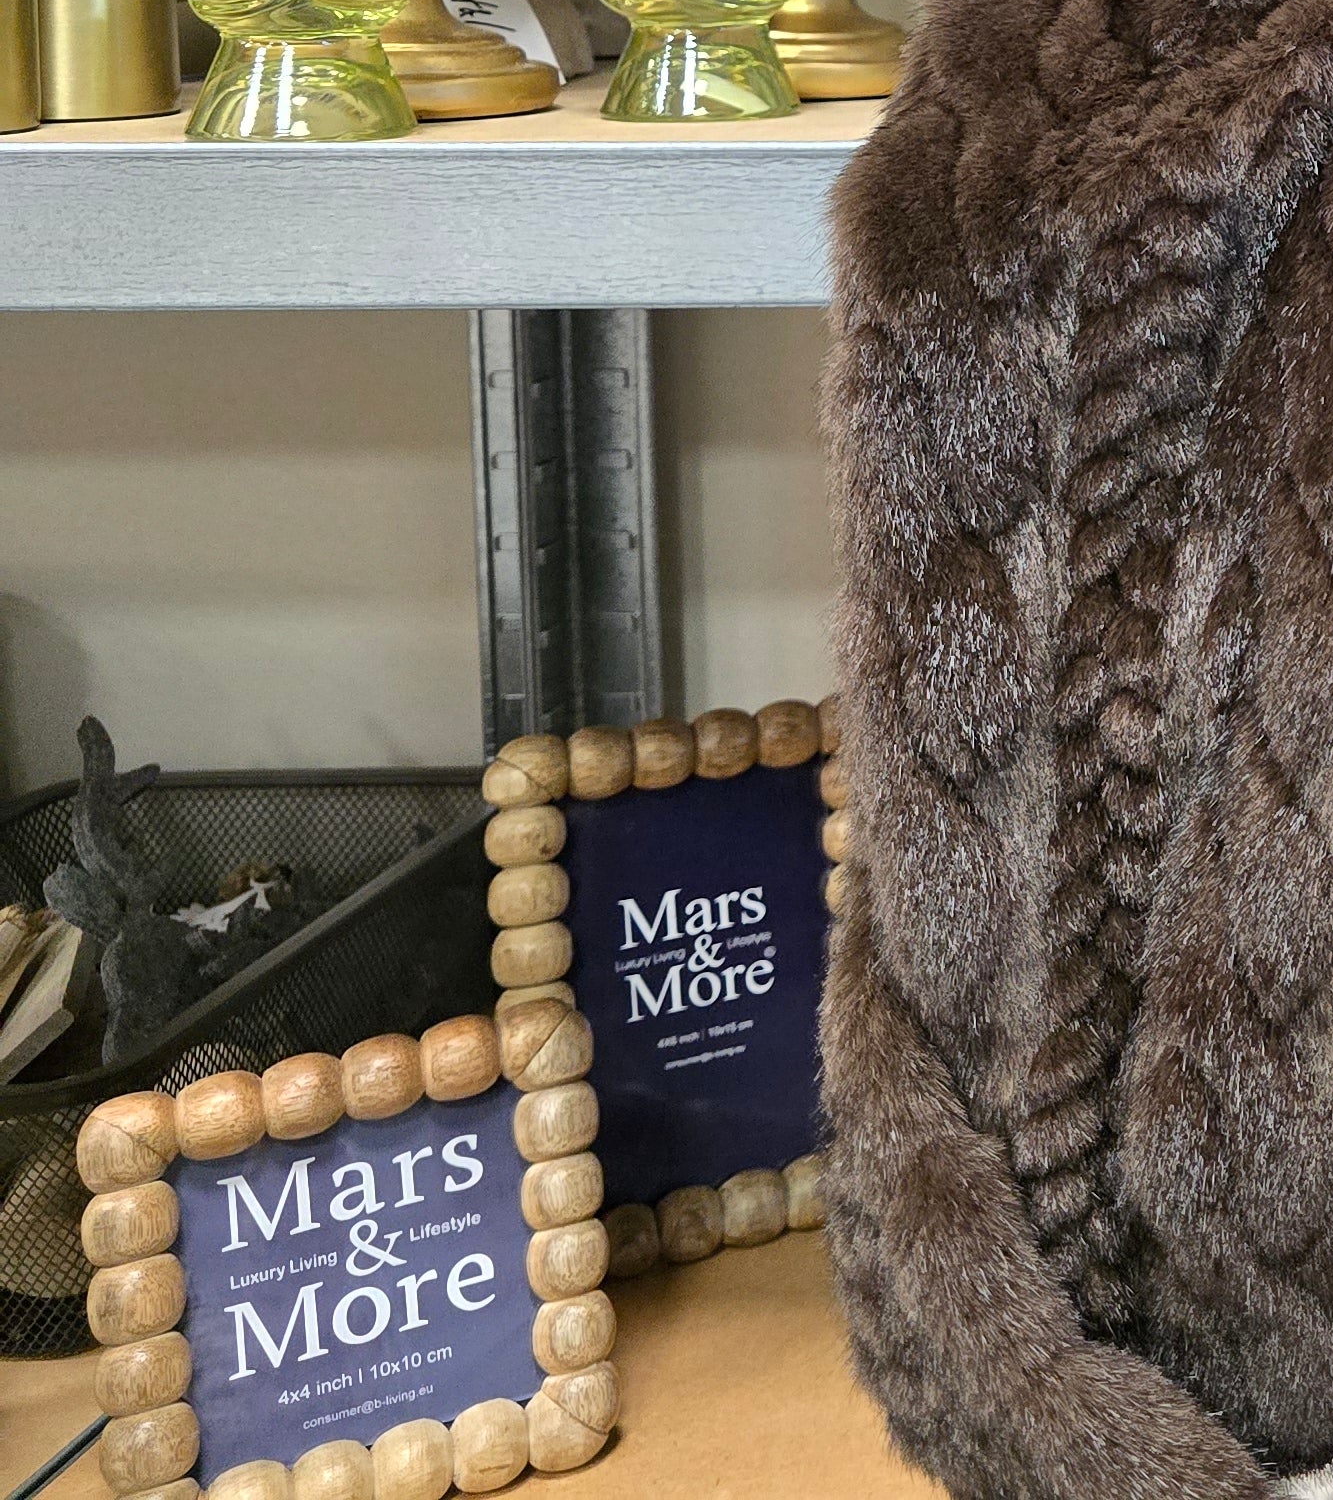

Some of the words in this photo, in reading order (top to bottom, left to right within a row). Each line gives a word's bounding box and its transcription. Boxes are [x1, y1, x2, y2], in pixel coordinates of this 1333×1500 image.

[618, 886, 767, 950] Mars
[687, 934, 726, 973] &
[624, 959, 775, 1023] More
[216, 1133, 485, 1253] Mars
[344, 1219, 408, 1278] &
[408, 1211, 482, 1243] Lifestyle
[230, 1263, 286, 1290] Luxury
[289, 1251, 338, 1275] Living
[224, 1248, 496, 1381] More
[277, 1384, 311, 1406] 4x4
[316, 1373, 353, 1396] inch
[369, 1352, 422, 1380] 10x10
[426, 1345, 453, 1364] cm
[302, 1383, 434, 1430] consumer@b-living.eu
